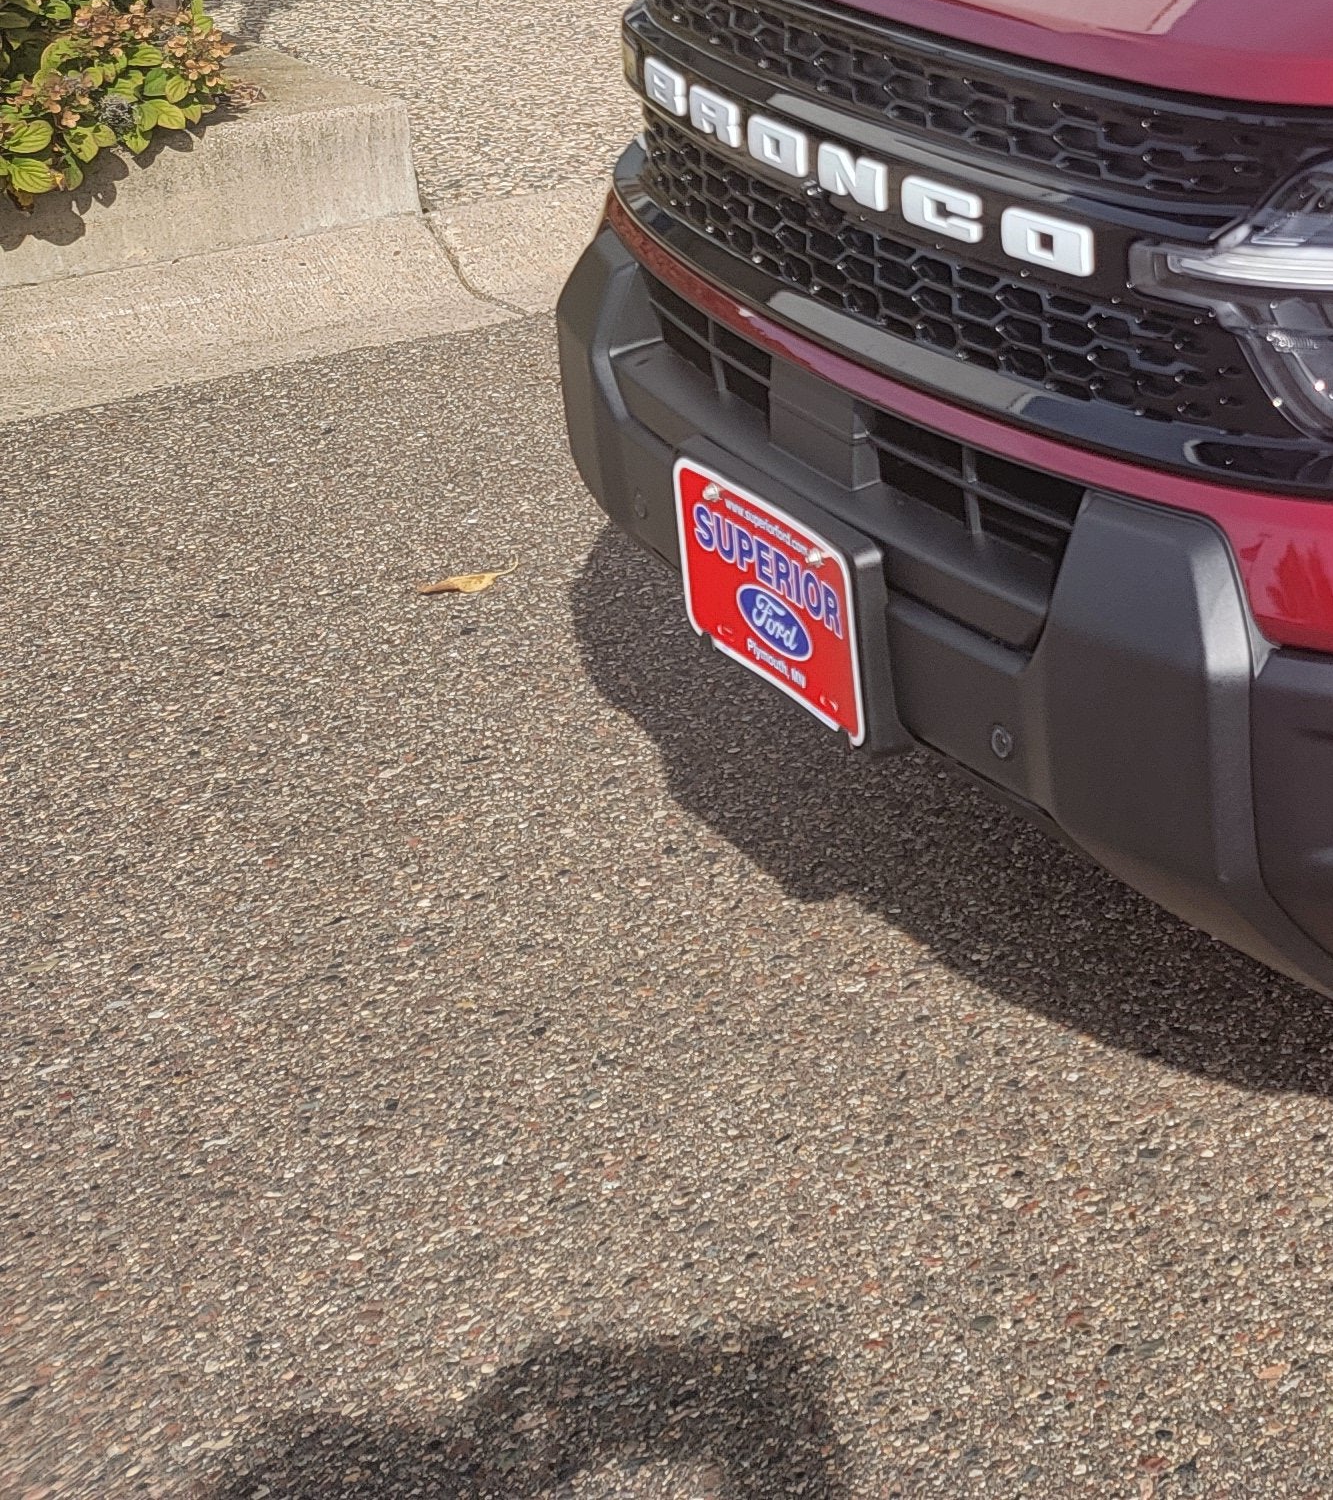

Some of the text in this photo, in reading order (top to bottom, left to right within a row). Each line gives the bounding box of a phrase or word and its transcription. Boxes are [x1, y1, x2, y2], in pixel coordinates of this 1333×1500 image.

[643, 55, 1095, 278] BRONCO
[693, 502, 844, 641] SUPERIOR
[751, 592, 799, 652] Ford
